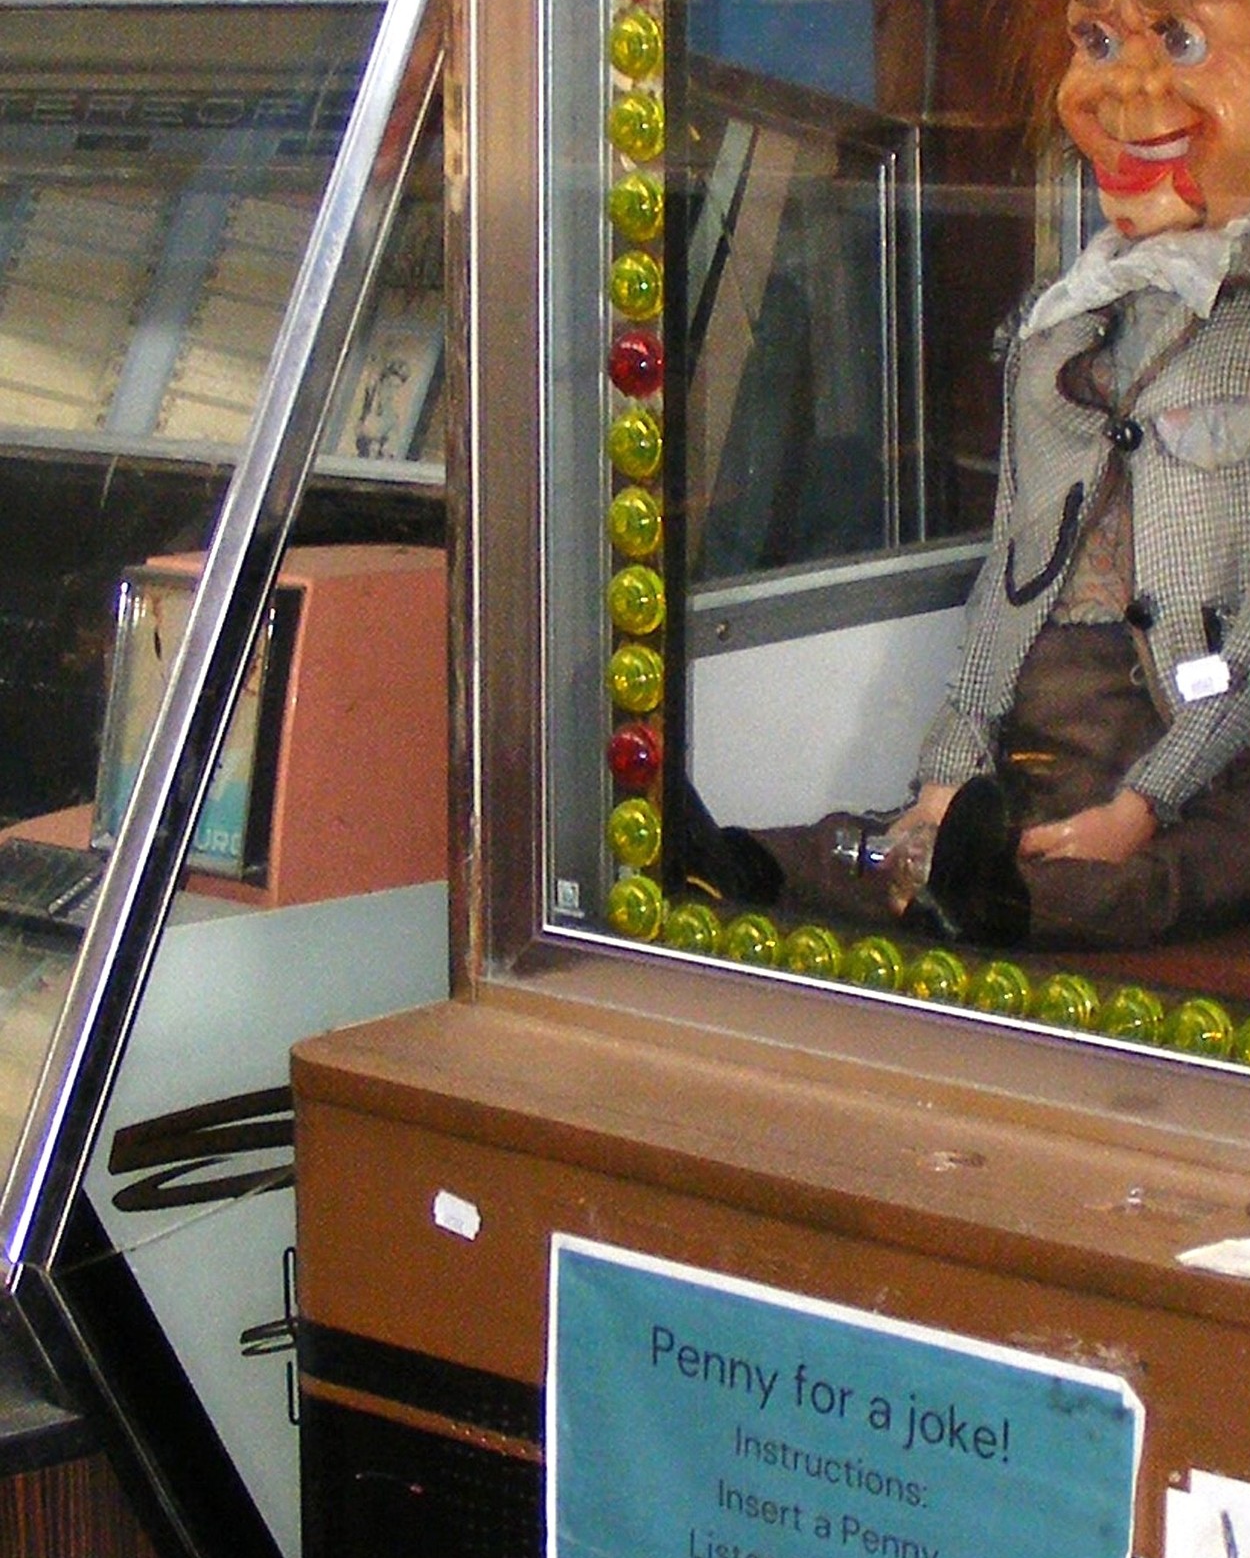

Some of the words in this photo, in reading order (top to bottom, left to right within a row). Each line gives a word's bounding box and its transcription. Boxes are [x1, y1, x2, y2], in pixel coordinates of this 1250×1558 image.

[650, 1325, 778, 1408] Penny
[794, 1364, 855, 1420] for
[869, 1394, 892, 1431] a
[903, 1393, 1010, 1463] joke!
[735, 1426, 928, 1508] Instructions:
[717, 1478, 802, 1533] Insert
[813, 1510, 832, 1539] a
